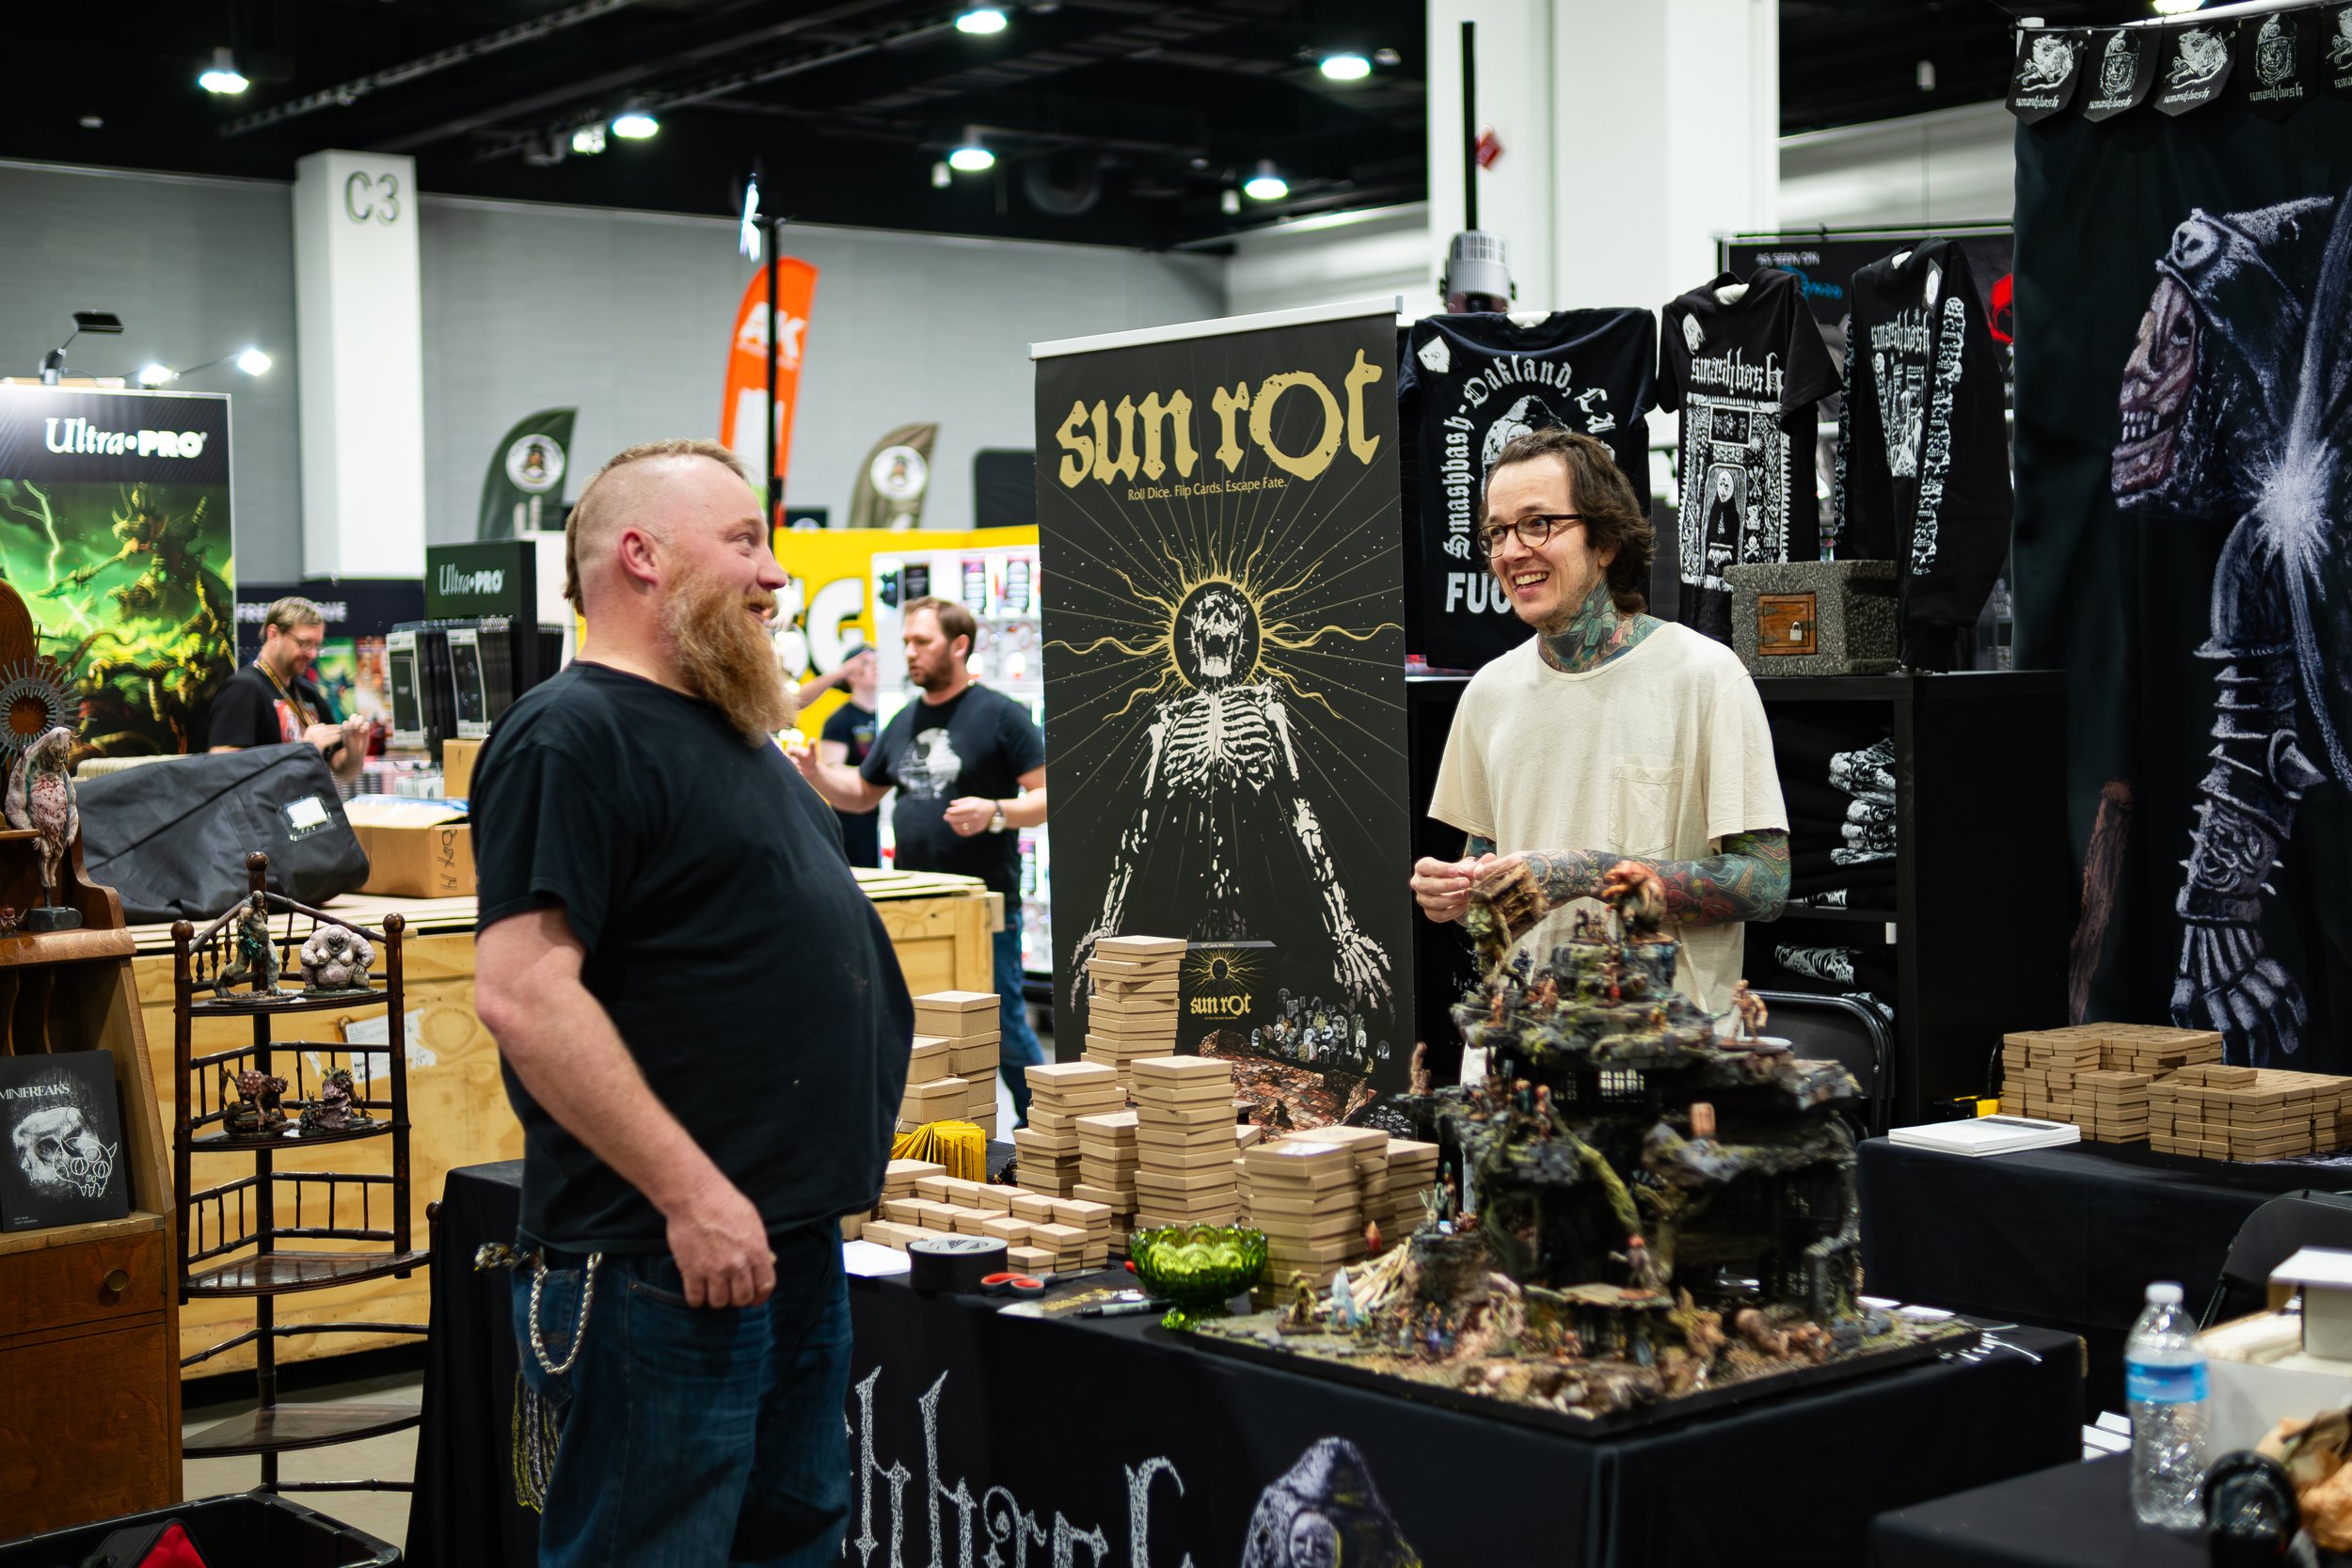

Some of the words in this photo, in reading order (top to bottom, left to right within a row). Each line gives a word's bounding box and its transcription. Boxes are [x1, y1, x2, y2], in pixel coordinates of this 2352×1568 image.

[344, 170, 400, 227] C3
[1056, 388, 1199, 488] sun
[1128, 488, 1145, 500] Roll
[1148, 486, 1172, 499] Dice.
[1175, 484, 1192, 499] Flip
[1193, 482, 1223, 495] Cards.
[1226, 480, 1261, 493] Escape
[1263, 476, 1287, 489] Fate.
[237, 602, 271, 623] FRE
[1190, 996, 1218, 1015] sun
